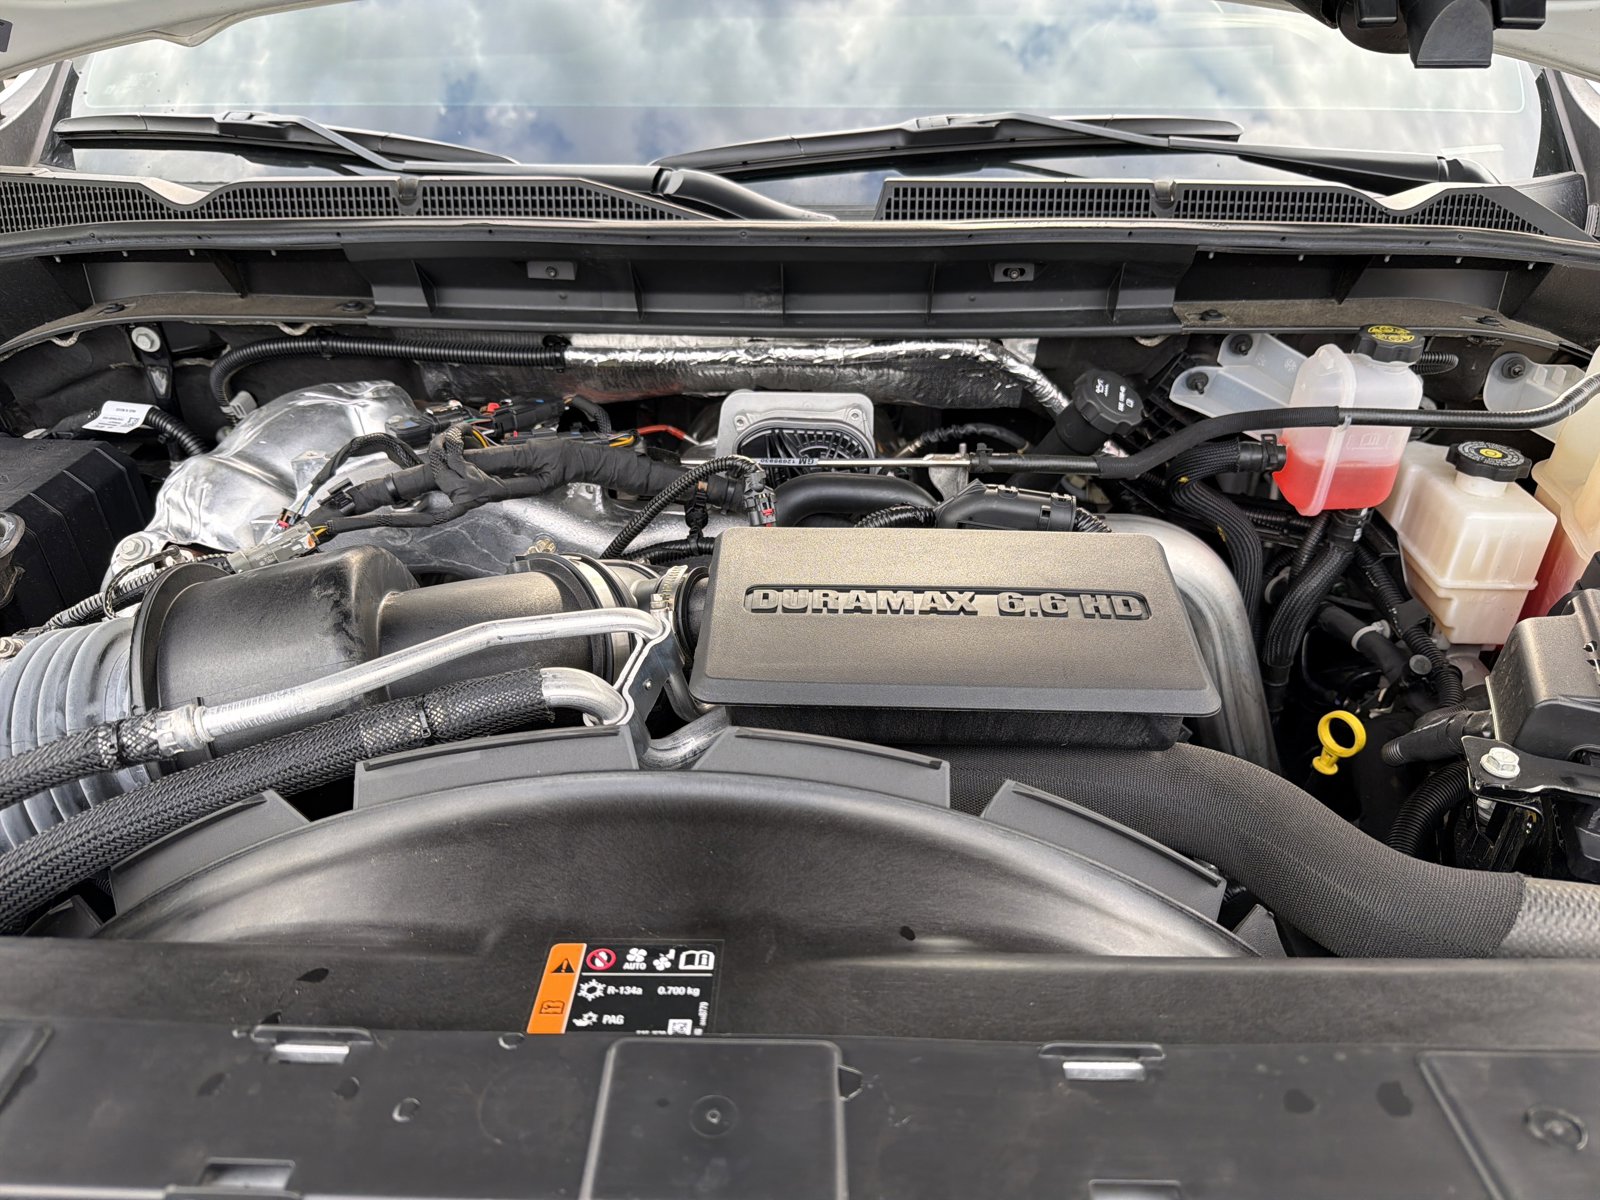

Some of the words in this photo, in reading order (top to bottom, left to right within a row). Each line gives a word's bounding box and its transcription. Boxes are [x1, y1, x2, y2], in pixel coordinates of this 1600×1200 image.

[750, 588, 978, 615] DURAMAX
[997, 591, 1069, 618] 6.6
[1081, 594, 1143, 619] HD
[622, 962, 647, 970] AUTO
[606, 985, 643, 995] R-134a
[657, 985, 686, 996] 0.700
[686, 986, 701, 997] kg
[602, 1014, 625, 1025] PAG
